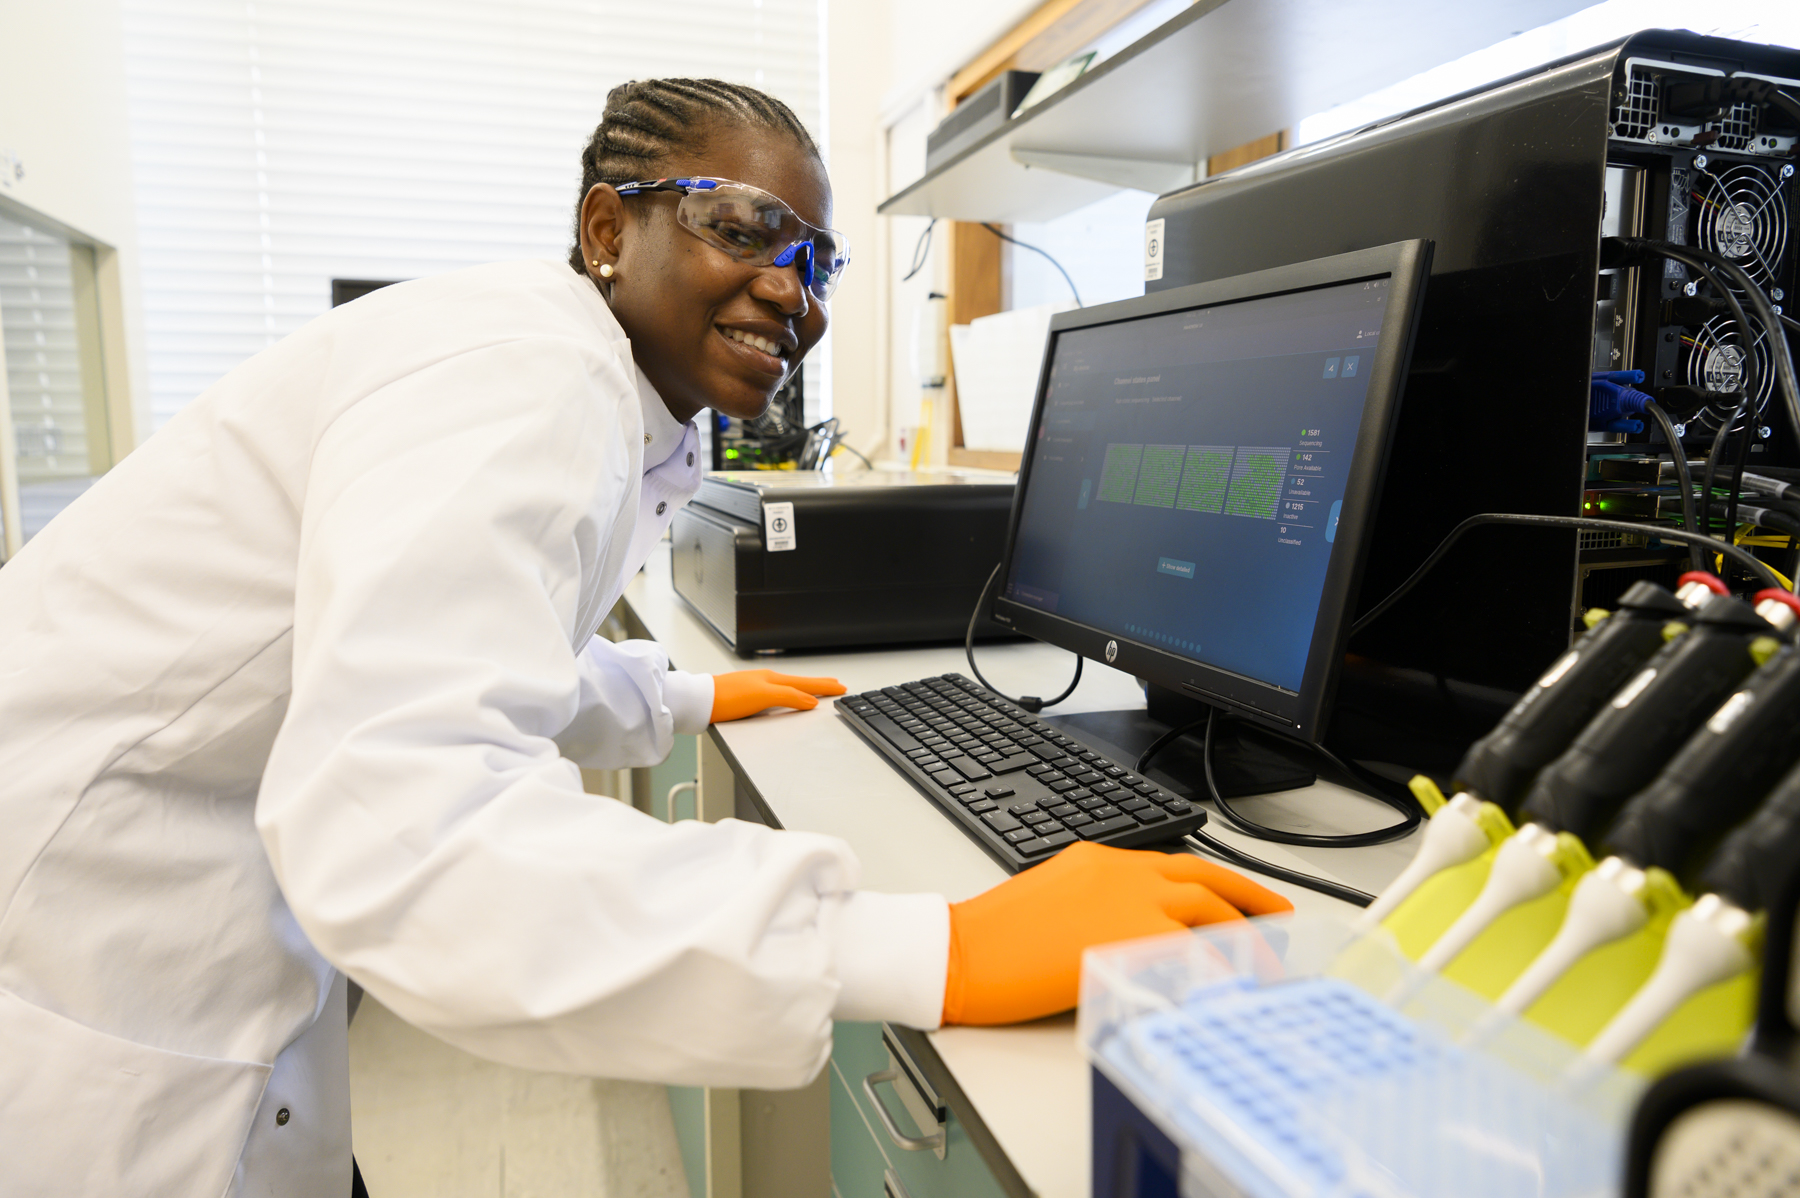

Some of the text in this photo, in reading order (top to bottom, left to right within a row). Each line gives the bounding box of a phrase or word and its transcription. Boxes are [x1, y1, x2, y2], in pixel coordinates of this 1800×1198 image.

[1296, 478, 1305, 486] 52
[1280, 526, 1287, 534] 10
[1277, 537, 1302, 546] Unclassified
